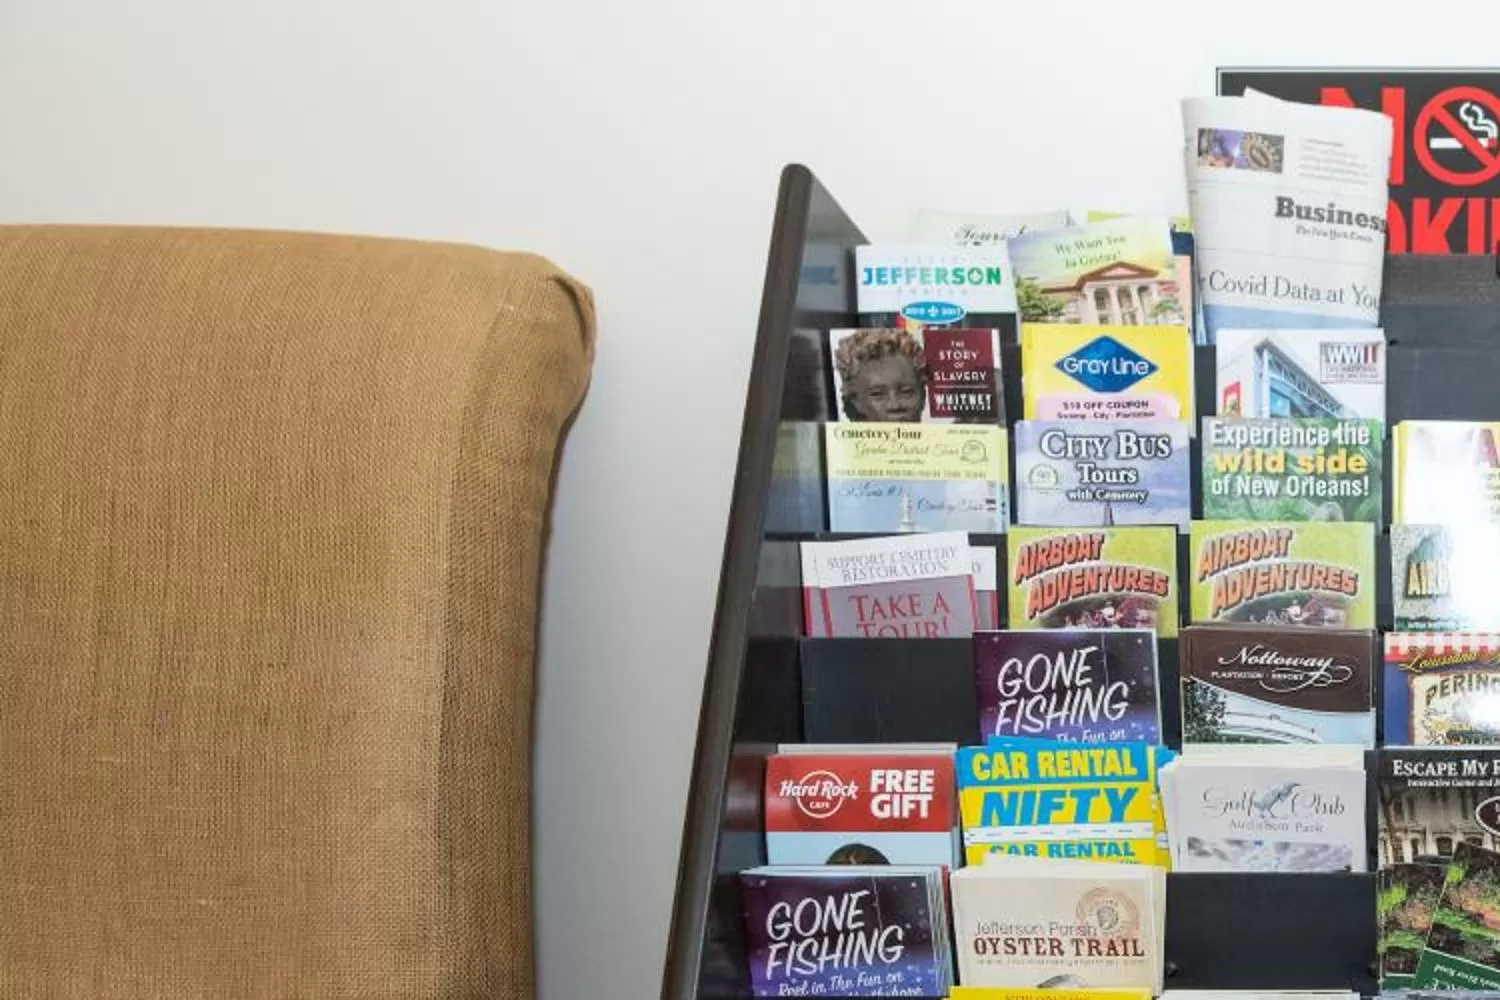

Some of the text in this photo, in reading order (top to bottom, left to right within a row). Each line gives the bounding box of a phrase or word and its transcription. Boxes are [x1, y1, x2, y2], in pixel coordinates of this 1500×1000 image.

[863, 267, 1002, 286] JEFFERSON
[1209, 270, 1344, 303] Covid Data at
[938, 350, 980, 362] STORY
[933, 370, 987, 382] SLAVERY
[1041, 431, 1172, 461] CITY BUS
[1211, 424, 1370, 449] Experience the
[1076, 462, 1138, 485] Tours
[1213, 449, 1369, 474] wild side
[1066, 491, 1148, 504] with Cemetery
[1210, 474, 1370, 498] of New Orleans!
[1012, 531, 1107, 587] AIRBOAT
[1027, 567, 1169, 618] ADVENTURES
[997, 645, 1099, 698] GONE
[1217, 643, 1336, 680] Nottoway
[995, 681, 1132, 737] FISHING
[972, 751, 1138, 780] CAR RENTAL
[1392, 758, 1458, 777] ESCAPE
[1462, 758, 1488, 777] MY
[778, 778, 860, 799] Hard Rock
[870, 769, 936, 793] FREE
[1407, 779, 1451, 788] Interactive
[1453, 779, 1475, 788] Game
[1477, 779, 1493, 788] and
[870, 794, 934, 820] GIFT
[980, 787, 1140, 827] NIFTY
[974, 921, 1098, 937] Jefferson Parish
[973, 937, 1146, 958] OYSTER TRAIL
